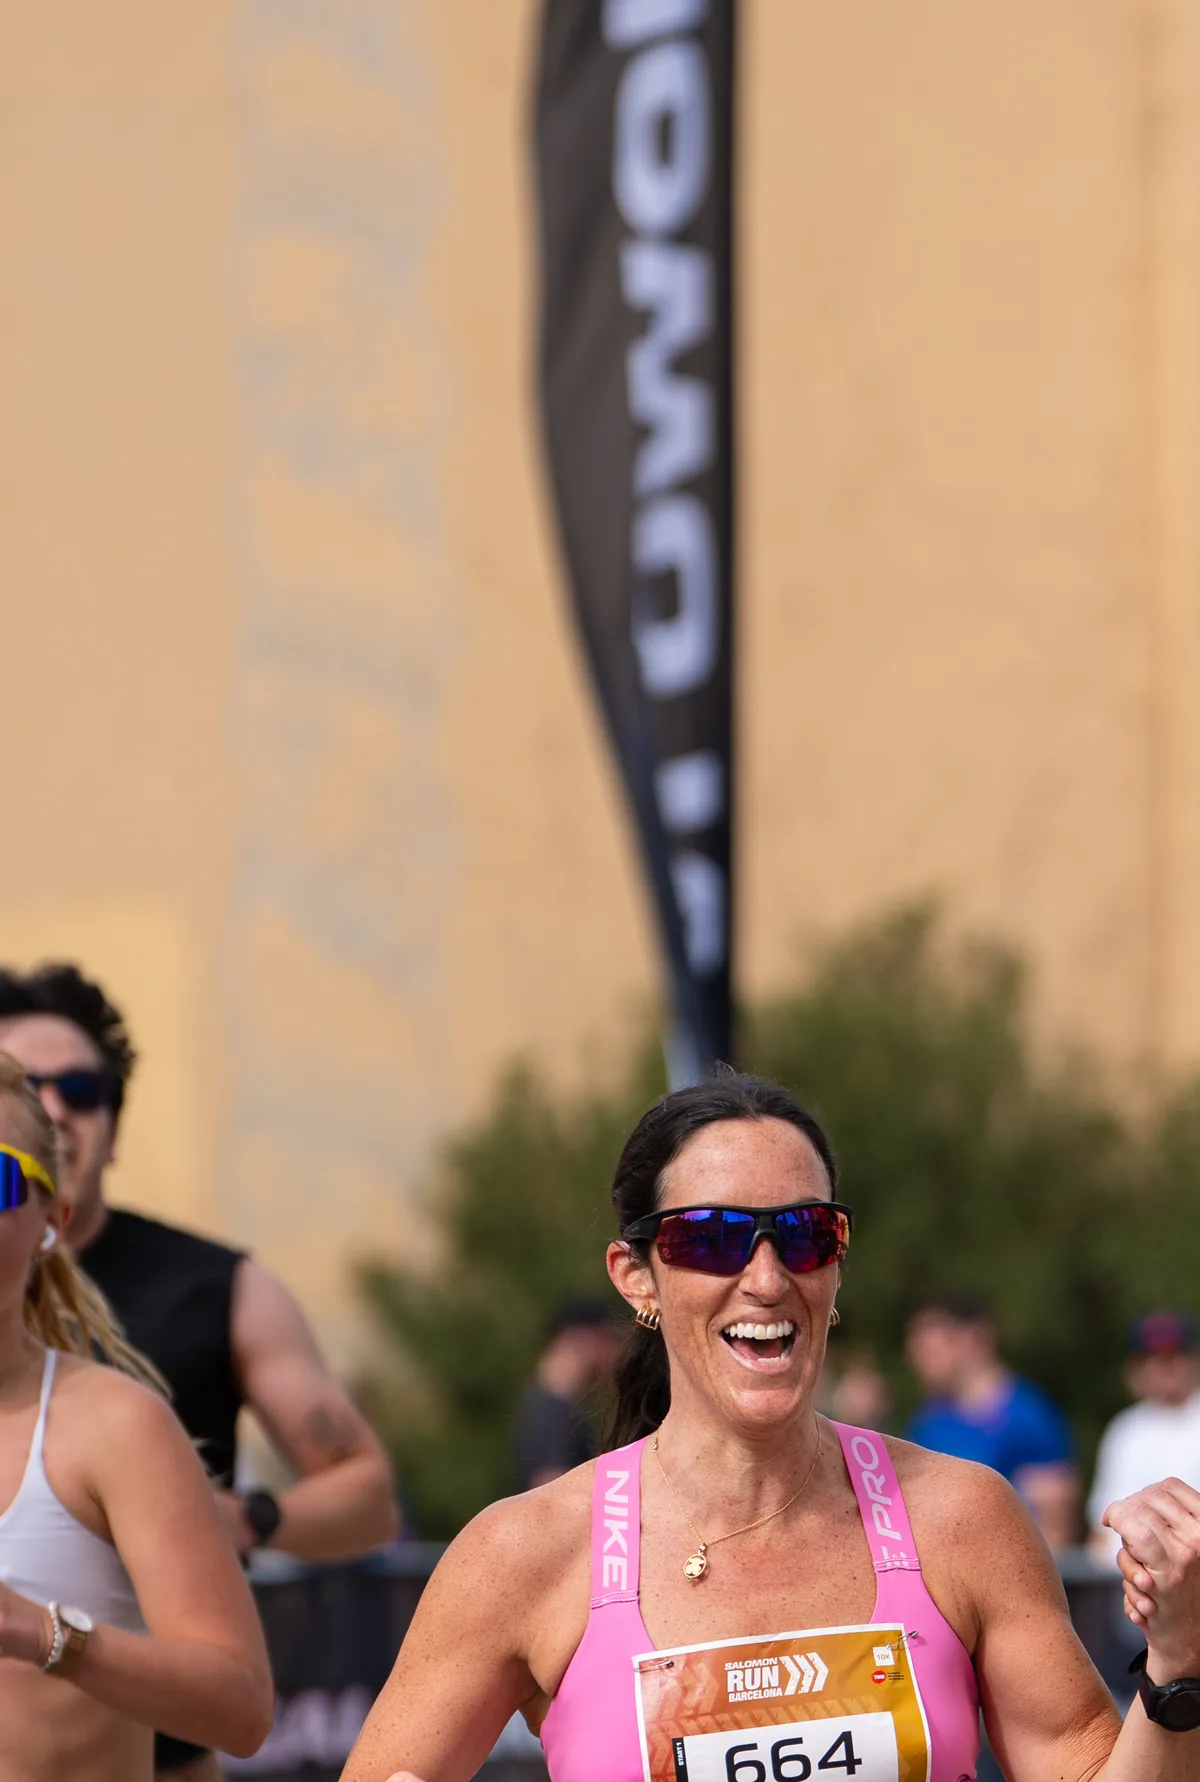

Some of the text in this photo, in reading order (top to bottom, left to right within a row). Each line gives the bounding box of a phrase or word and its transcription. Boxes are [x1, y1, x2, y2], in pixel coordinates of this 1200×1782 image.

[851, 1436, 902, 1541] PRO
[602, 1469, 630, 1590] NIKE
[724, 1657, 779, 1671] SALOMON
[727, 1665, 780, 1693] RUN
[728, 1687, 783, 1703] BARCELONA
